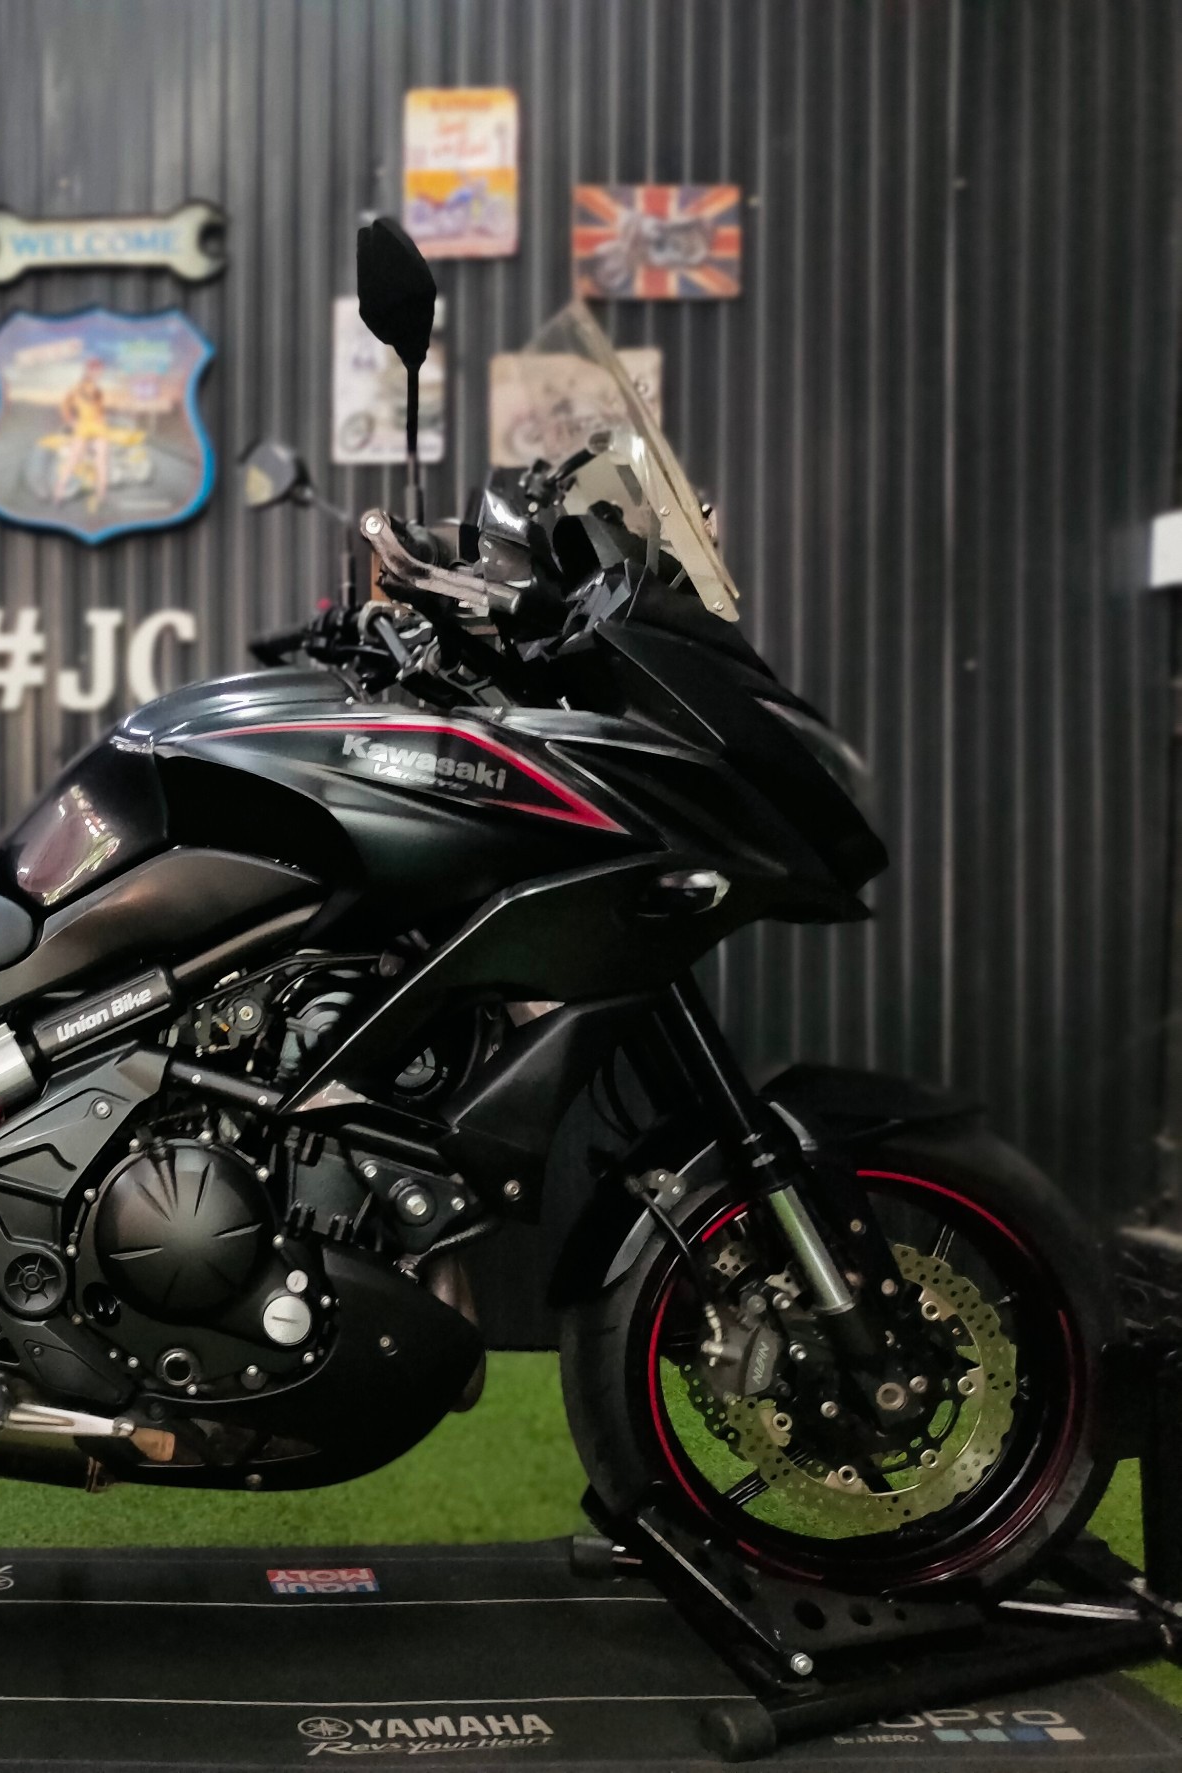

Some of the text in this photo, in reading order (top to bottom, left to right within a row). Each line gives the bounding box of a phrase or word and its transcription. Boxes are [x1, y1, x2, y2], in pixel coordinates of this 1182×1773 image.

[10, 229, 181, 257] WELCOME
[342, 734, 507, 791] Kawasaki
[57, 989, 153, 1042] Union Bike
[273, 1568, 370, 1582] MOLY
[276, 1581, 376, 1593] LIQUI
[355, 1714, 554, 1738] YAMAHA
